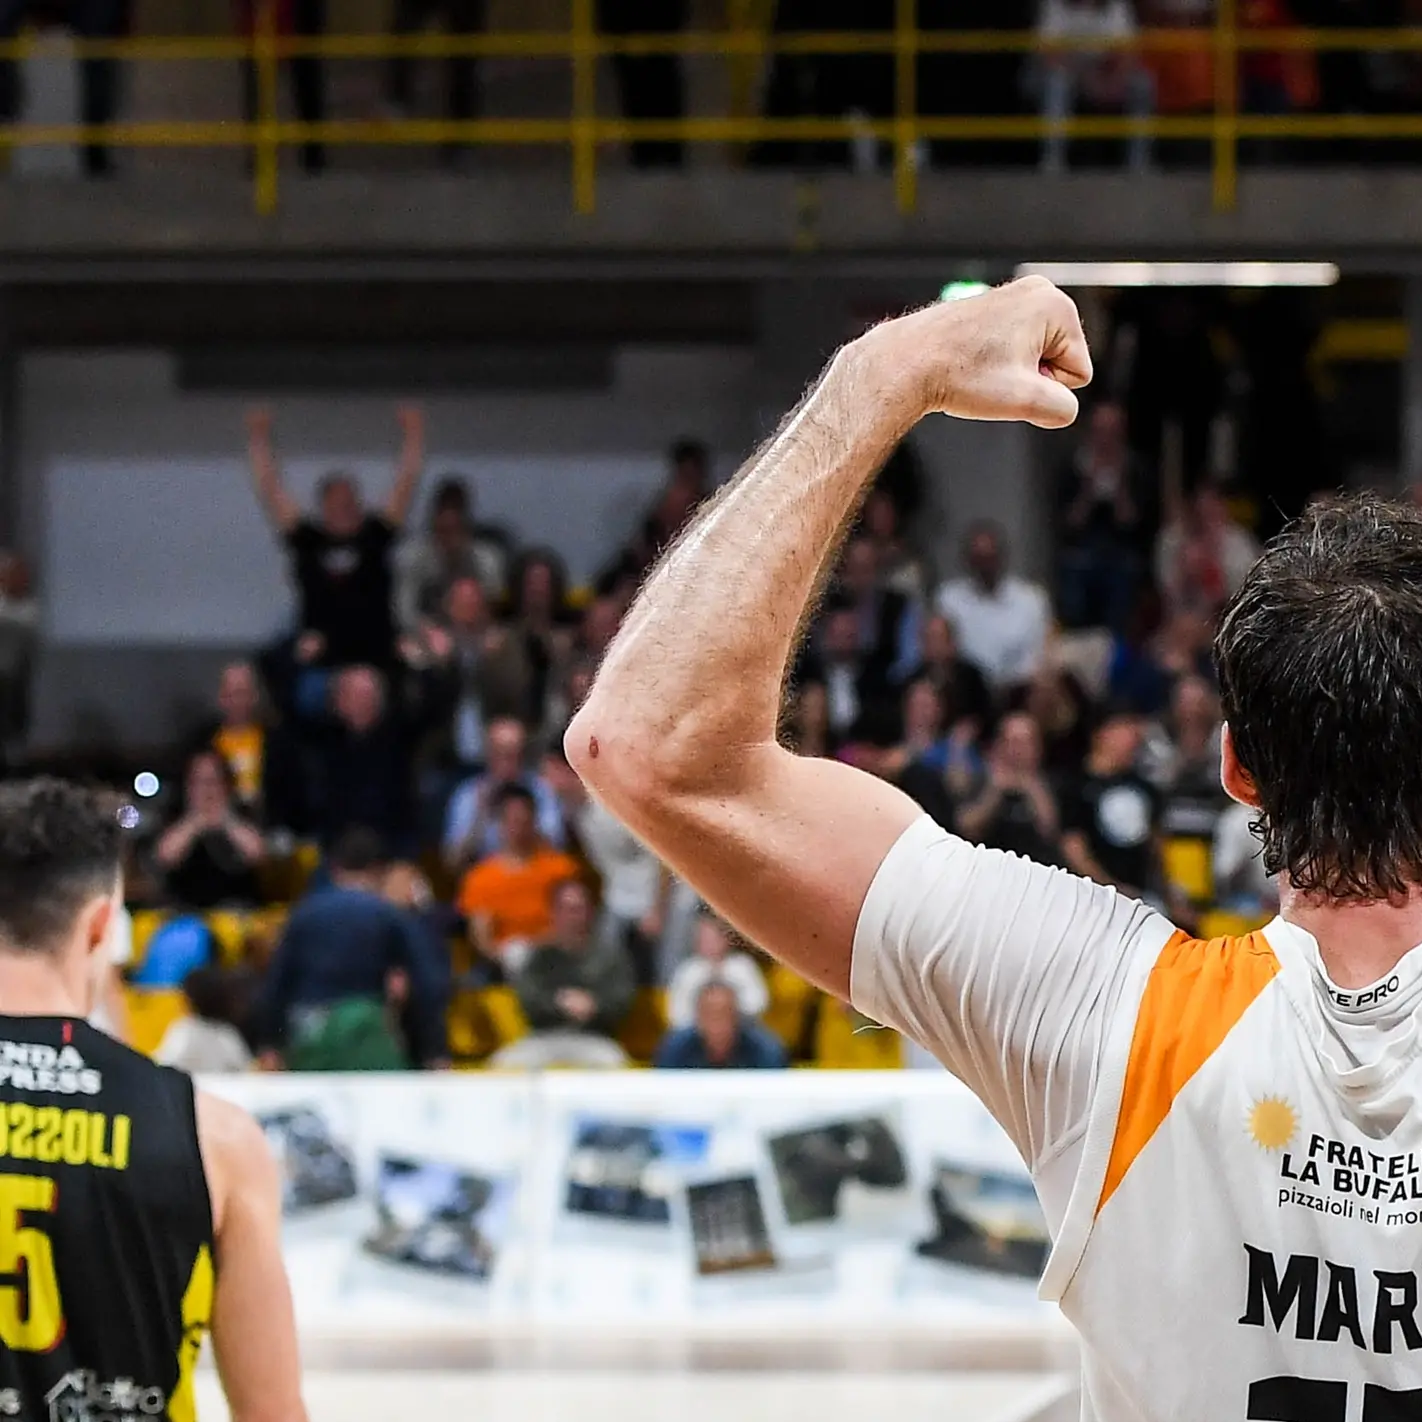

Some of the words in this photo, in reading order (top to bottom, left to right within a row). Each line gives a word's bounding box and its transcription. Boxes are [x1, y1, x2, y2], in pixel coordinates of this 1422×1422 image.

[1356, 975, 1399, 1007] PRO
[0, 1040, 84, 1070] NDA
[1280, 1153, 1320, 1186] LA
[1278, 1186, 1354, 1219] pizzaioli
